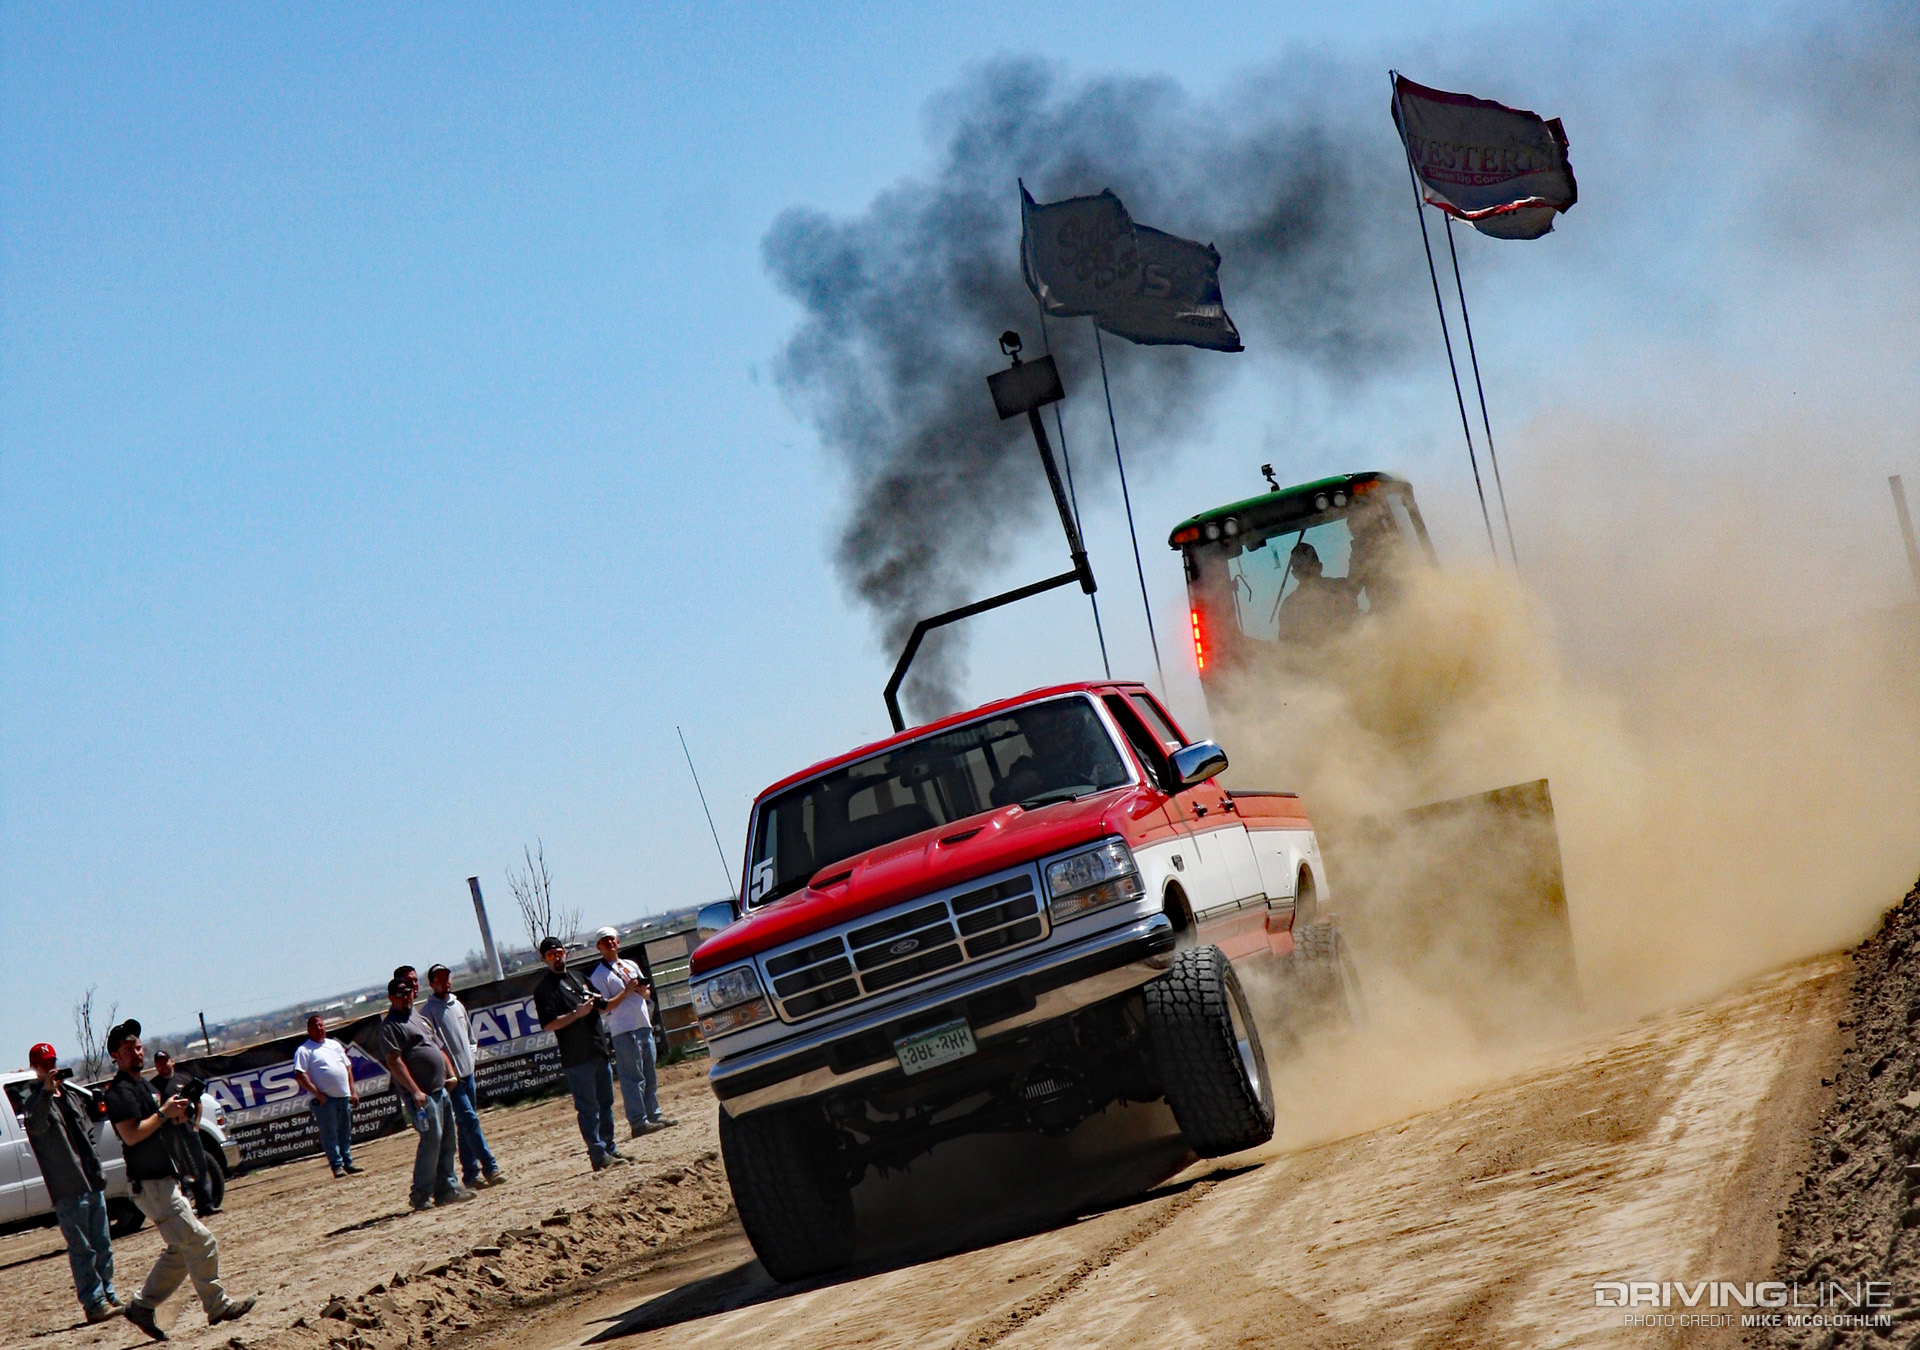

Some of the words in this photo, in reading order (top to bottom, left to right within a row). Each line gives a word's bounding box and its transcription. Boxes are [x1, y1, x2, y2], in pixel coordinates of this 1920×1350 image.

[751, 857, 774, 903] 5
[475, 1054, 526, 1076] nsmissions
[534, 1051, 555, 1064] Five
[206, 1065, 300, 1114] ATS
[269, 1117, 290, 1131] Five
[291, 1113, 311, 1126] Star
[274, 1128, 304, 1143] Power
[352, 1105, 398, 1123] Manifolds
